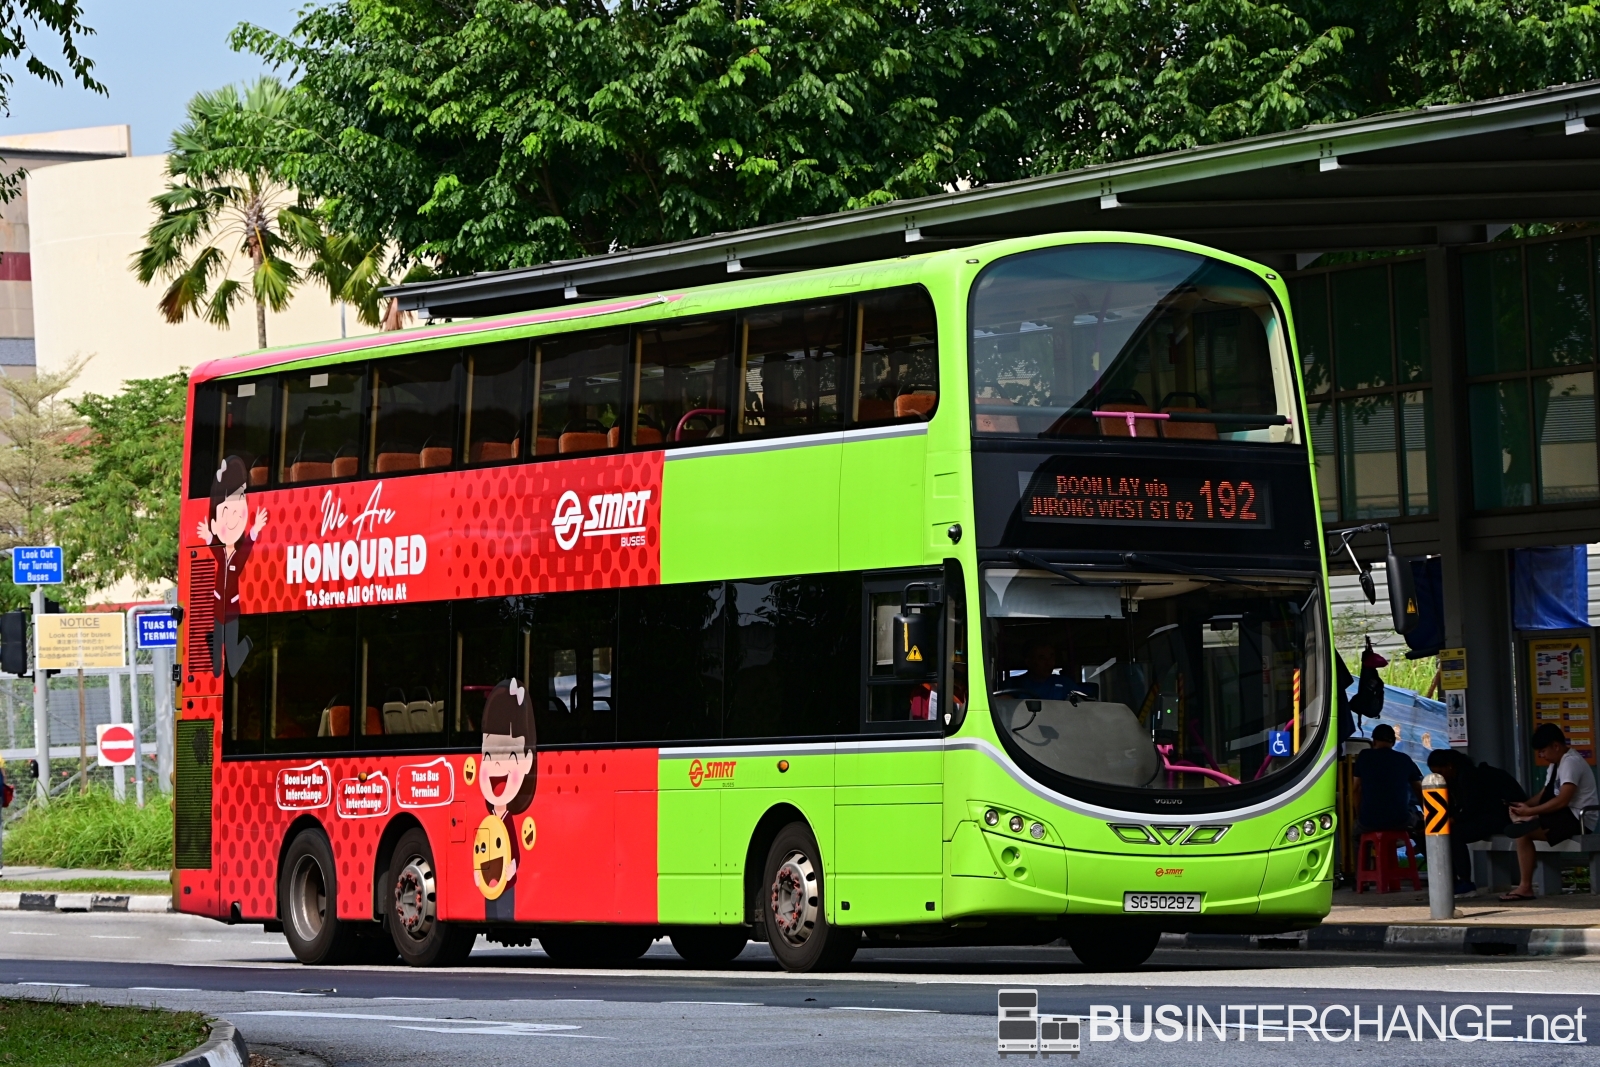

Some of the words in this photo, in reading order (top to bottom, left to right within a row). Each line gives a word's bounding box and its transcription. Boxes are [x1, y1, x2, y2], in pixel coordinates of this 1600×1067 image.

[1056, 475, 1102, 495] BOON
[1107, 477, 1140, 496] LAY
[1144, 478, 1168, 497] via
[1199, 480, 1257, 520] 192
[320, 489, 348, 538] We
[353, 481, 396, 541] Are
[584, 490, 652, 528] SMRT
[1029, 497, 1095, 517] JURONG
[1097, 500, 1145, 518] WEST
[1150, 500, 1170, 519] ST
[1175, 502, 1195, 520] 62
[621, 535, 646, 547] BUSES
[22, 549, 38, 559] Look
[40, 549, 53, 559] Out
[286, 534, 427, 584] HONOURED
[18, 561, 29, 570] for
[32, 560, 57, 572] Turning
[27, 572, 49, 581] Buses
[306, 589, 318, 607] To
[319, 588, 345, 606] Serve
[346, 585, 360, 604] All
[361, 584, 374, 602] Of
[376, 584, 394, 602] You
[394, 583, 407, 601] At
[60, 617, 99, 627] NOTICE
[143, 620, 164, 630] TUAS
[167, 620, 177, 629] BU
[143, 631, 177, 641] TERMIN
[411, 770, 426, 782] Tuas
[427, 770, 440, 782] Bus
[704, 761, 737, 778] SMRT
[284, 774, 299, 785] Boon
[300, 773, 311, 788] Lay
[311, 773, 323, 784] Bus
[344, 783, 355, 794] Joo
[356, 783, 371, 794] Koon
[372, 782, 383, 794] Bus
[285, 788, 322, 803] Interchange
[411, 785, 440, 798] Terminal
[346, 797, 382, 812] Interchange
[1130, 895, 1195, 910] SG5029Z
